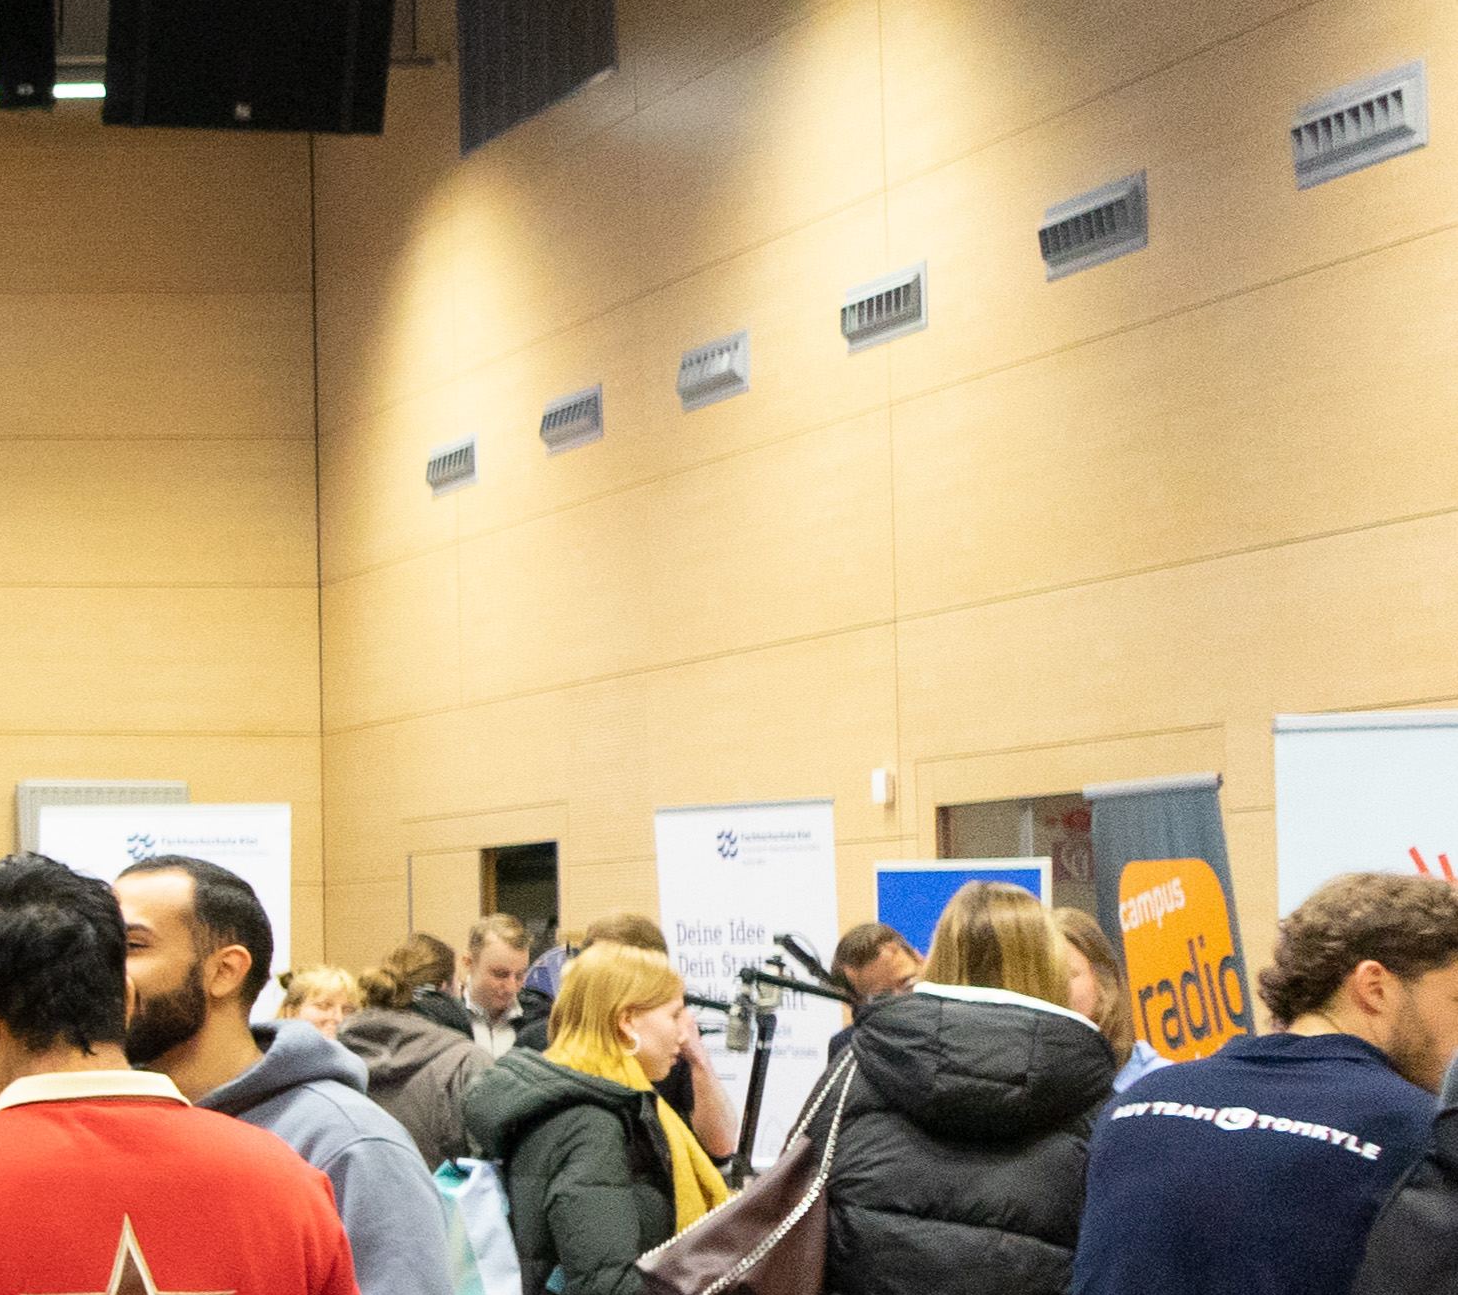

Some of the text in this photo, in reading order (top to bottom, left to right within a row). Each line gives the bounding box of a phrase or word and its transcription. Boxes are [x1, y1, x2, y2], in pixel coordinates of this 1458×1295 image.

[1119, 876, 1186, 933] campus
[676, 917, 765, 946] Deine Idee
[678, 953, 715, 978] Dein
[1138, 934, 1247, 1050] radio
[1150, 1100, 1216, 1122] TEAM
